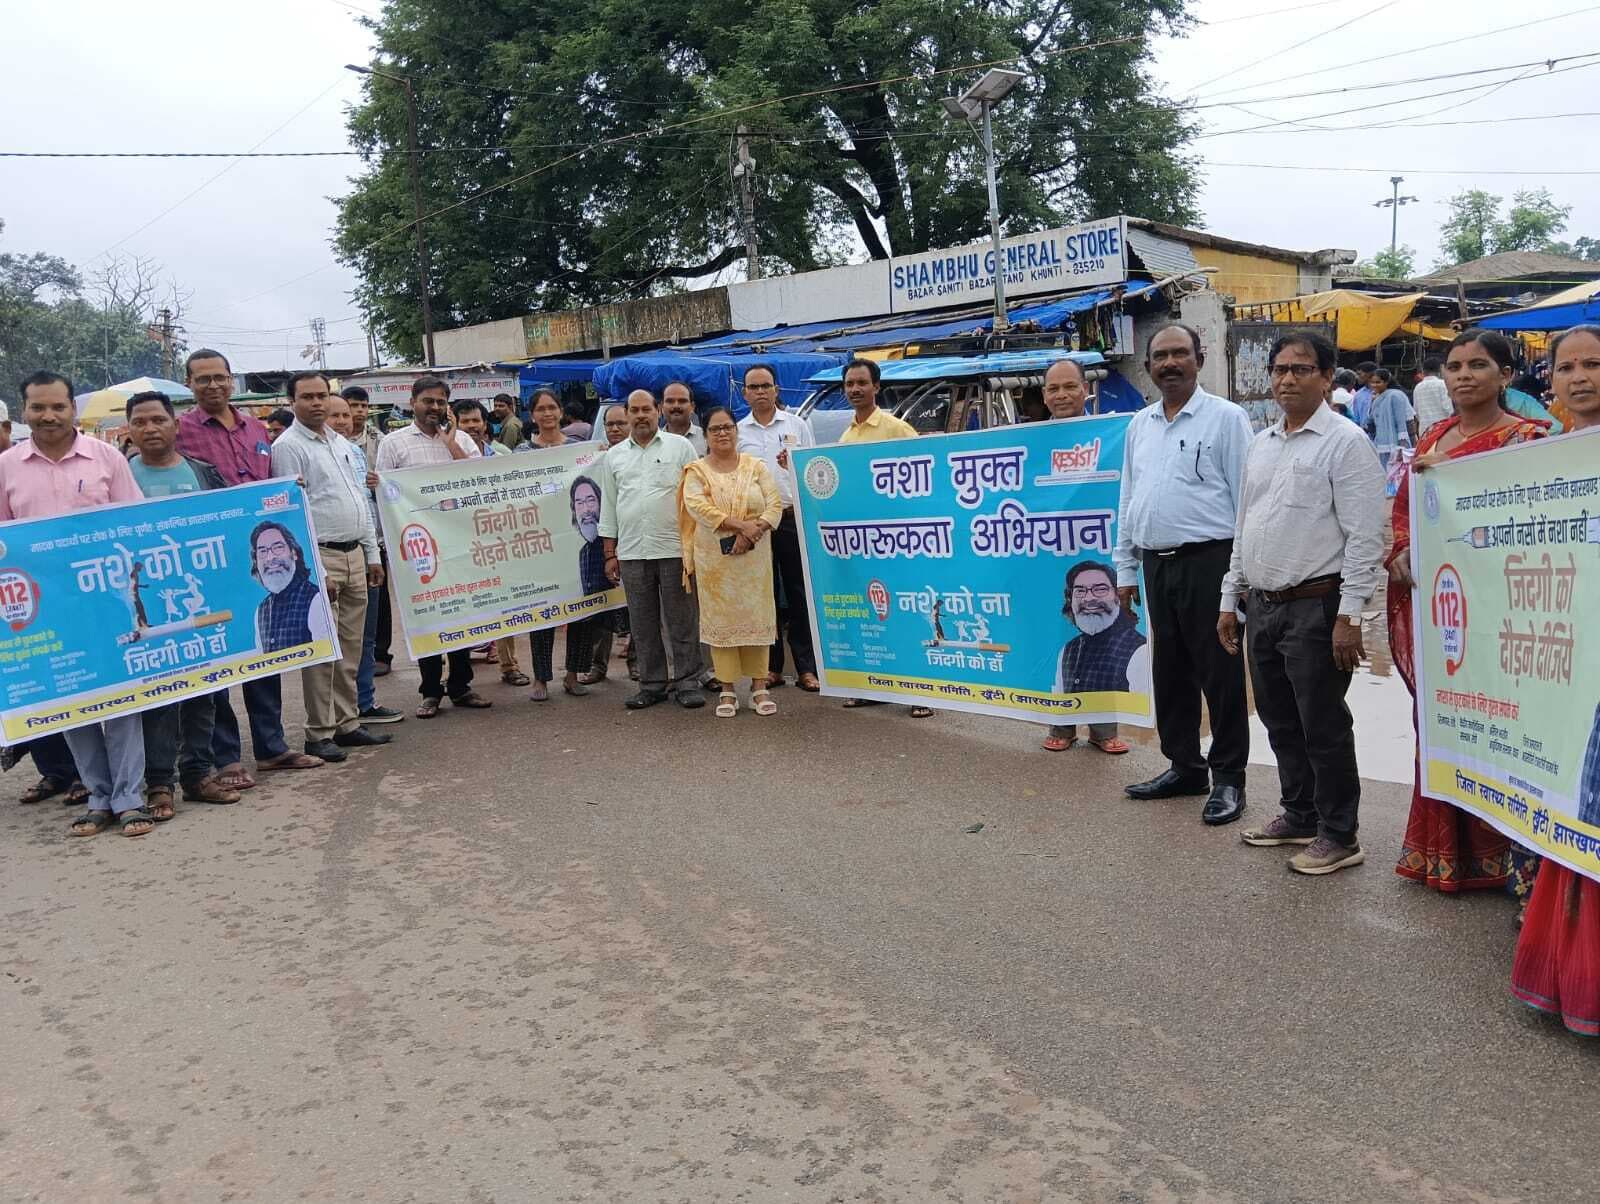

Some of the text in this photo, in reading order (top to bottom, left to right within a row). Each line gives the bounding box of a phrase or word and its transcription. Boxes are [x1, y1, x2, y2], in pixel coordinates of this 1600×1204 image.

[894, 253, 978, 289] SHAMBHU
[1066, 227, 1119, 261] STORE
[908, 286, 934, 300] BAZAR
[937, 280, 964, 296] SAMITI
[1031, 264, 1062, 281] KHUNTI
[1072, 259, 1104, 275] 835210
[873, 450, 1025, 501] नशा मुक्त
[460, 491, 482, 508] अपनी
[472, 499, 540, 537] जिंदगी को
[820, 504, 1111, 557] जागरूकता अभियान
[1490, 516, 1515, 548] अपनी
[1515, 515, 1537, 546] नसों
[1537, 513, 1547, 545] में
[1547, 519, 1568, 544] नशा
[407, 536, 431, 559] 112
[511, 529, 554, 562] दीजिये
[70, 534, 228, 592] नशे को ना
[0, 581, 28, 605] 112
[872, 589, 886, 605] 112
[1504, 551, 1577, 614] जिंदगी को
[896, 585, 939, 614] नशे
[941, 585, 974, 615] को
[976, 592, 1011, 617] ना
[1439, 591, 1460, 628] 112
[439, 630, 465, 644] जिला
[1538, 621, 1574, 687] दीजिये
[122, 637, 179, 676] जिंदगी
[180, 633, 205, 660] को
[966, 653, 986, 671] को
[868, 676, 893, 688] जिला
[25, 709, 70, 730] जिला
[1456, 769, 1476, 796] जिला
